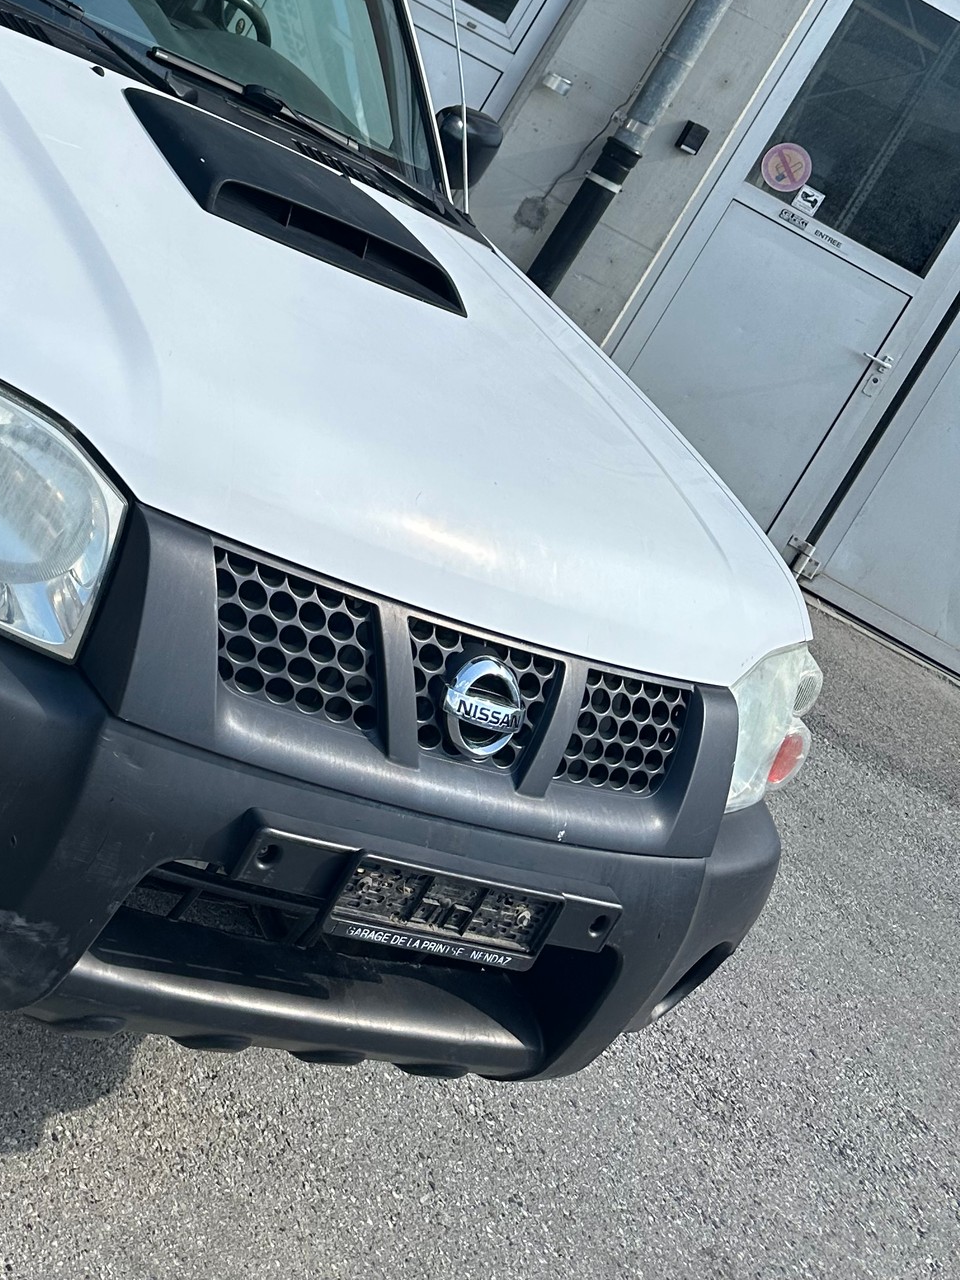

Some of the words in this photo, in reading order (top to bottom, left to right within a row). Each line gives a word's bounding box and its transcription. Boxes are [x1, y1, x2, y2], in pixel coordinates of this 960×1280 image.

[457, 699, 521, 729] NISSAN
[346, 926, 392, 943] GARAGE
[390, 935, 408, 946] DE
